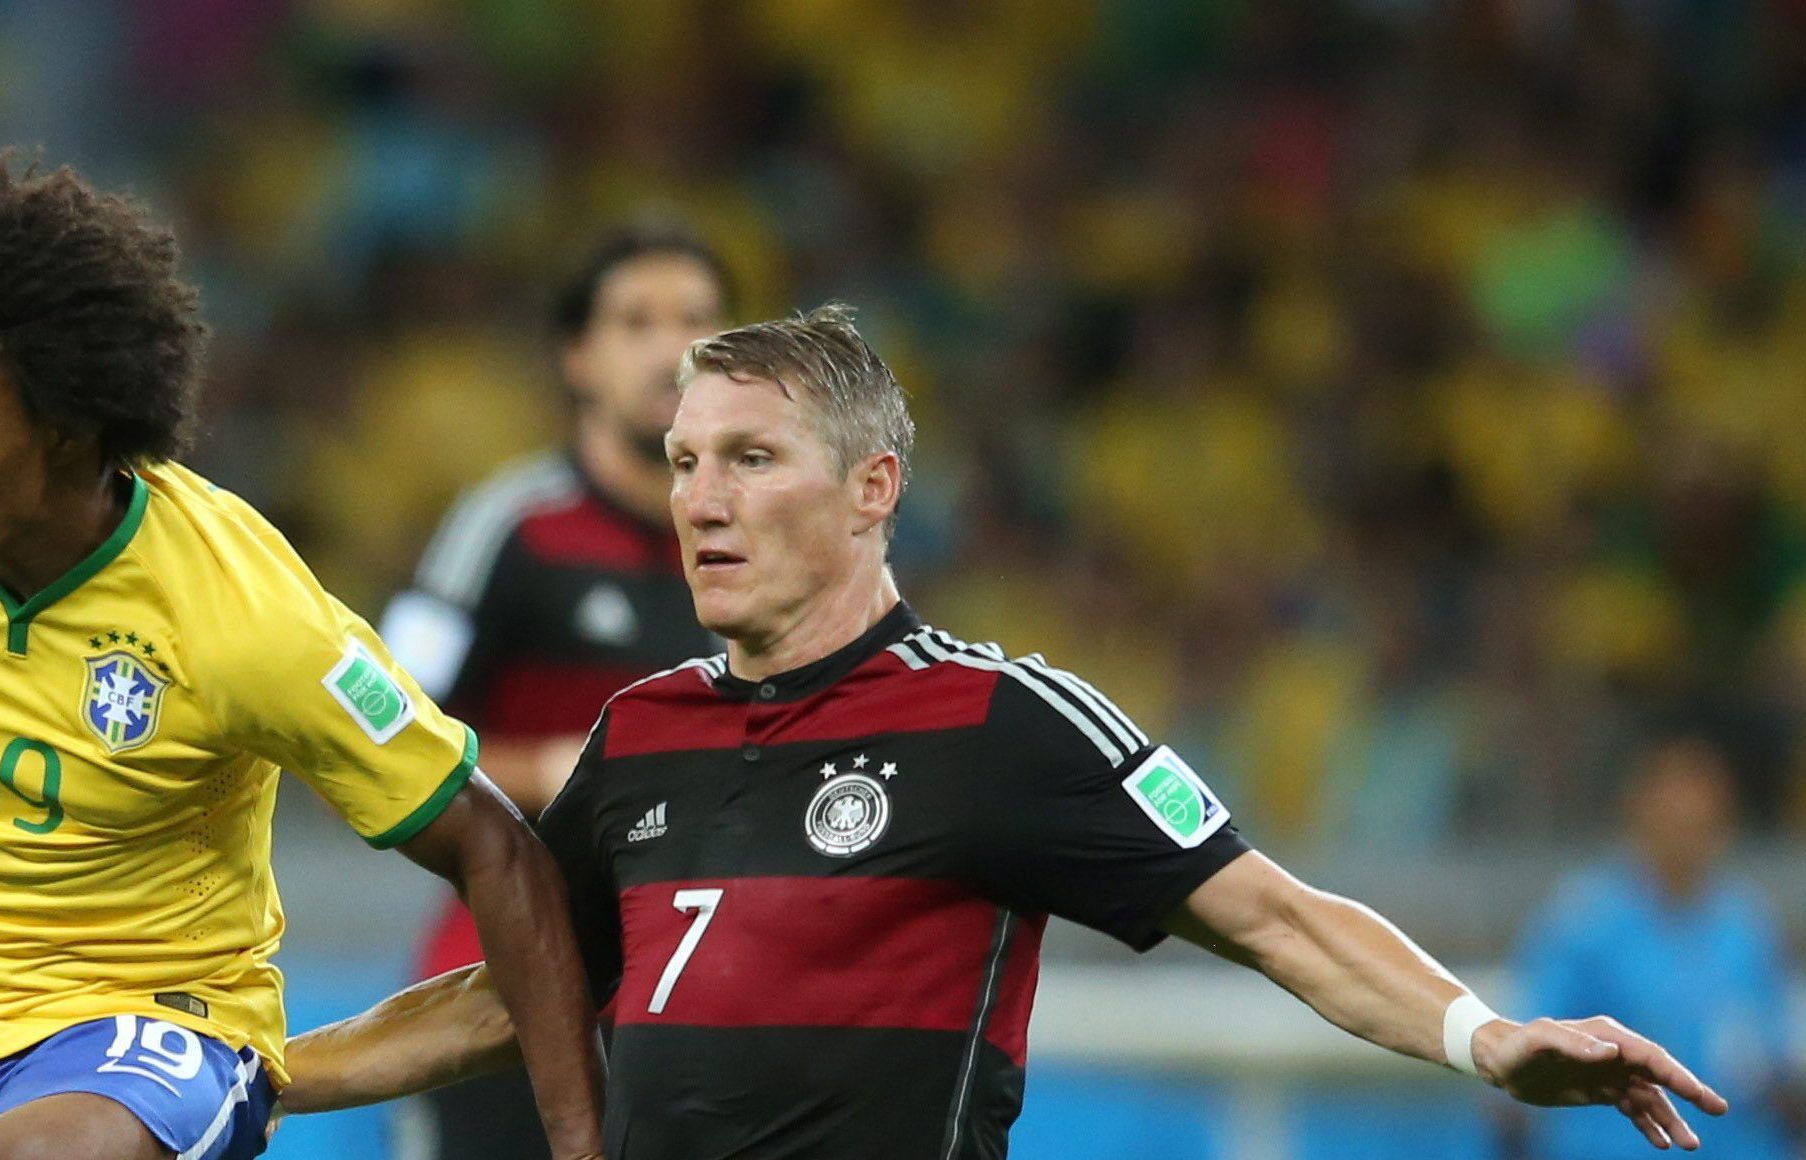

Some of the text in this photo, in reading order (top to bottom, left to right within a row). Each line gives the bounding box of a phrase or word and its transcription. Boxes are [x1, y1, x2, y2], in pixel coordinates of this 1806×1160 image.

[108, 691, 135, 707] CBF
[627, 825, 668, 842] adidas
[647, 888, 724, 1014] 7
[100, 1015, 203, 1086] 19
